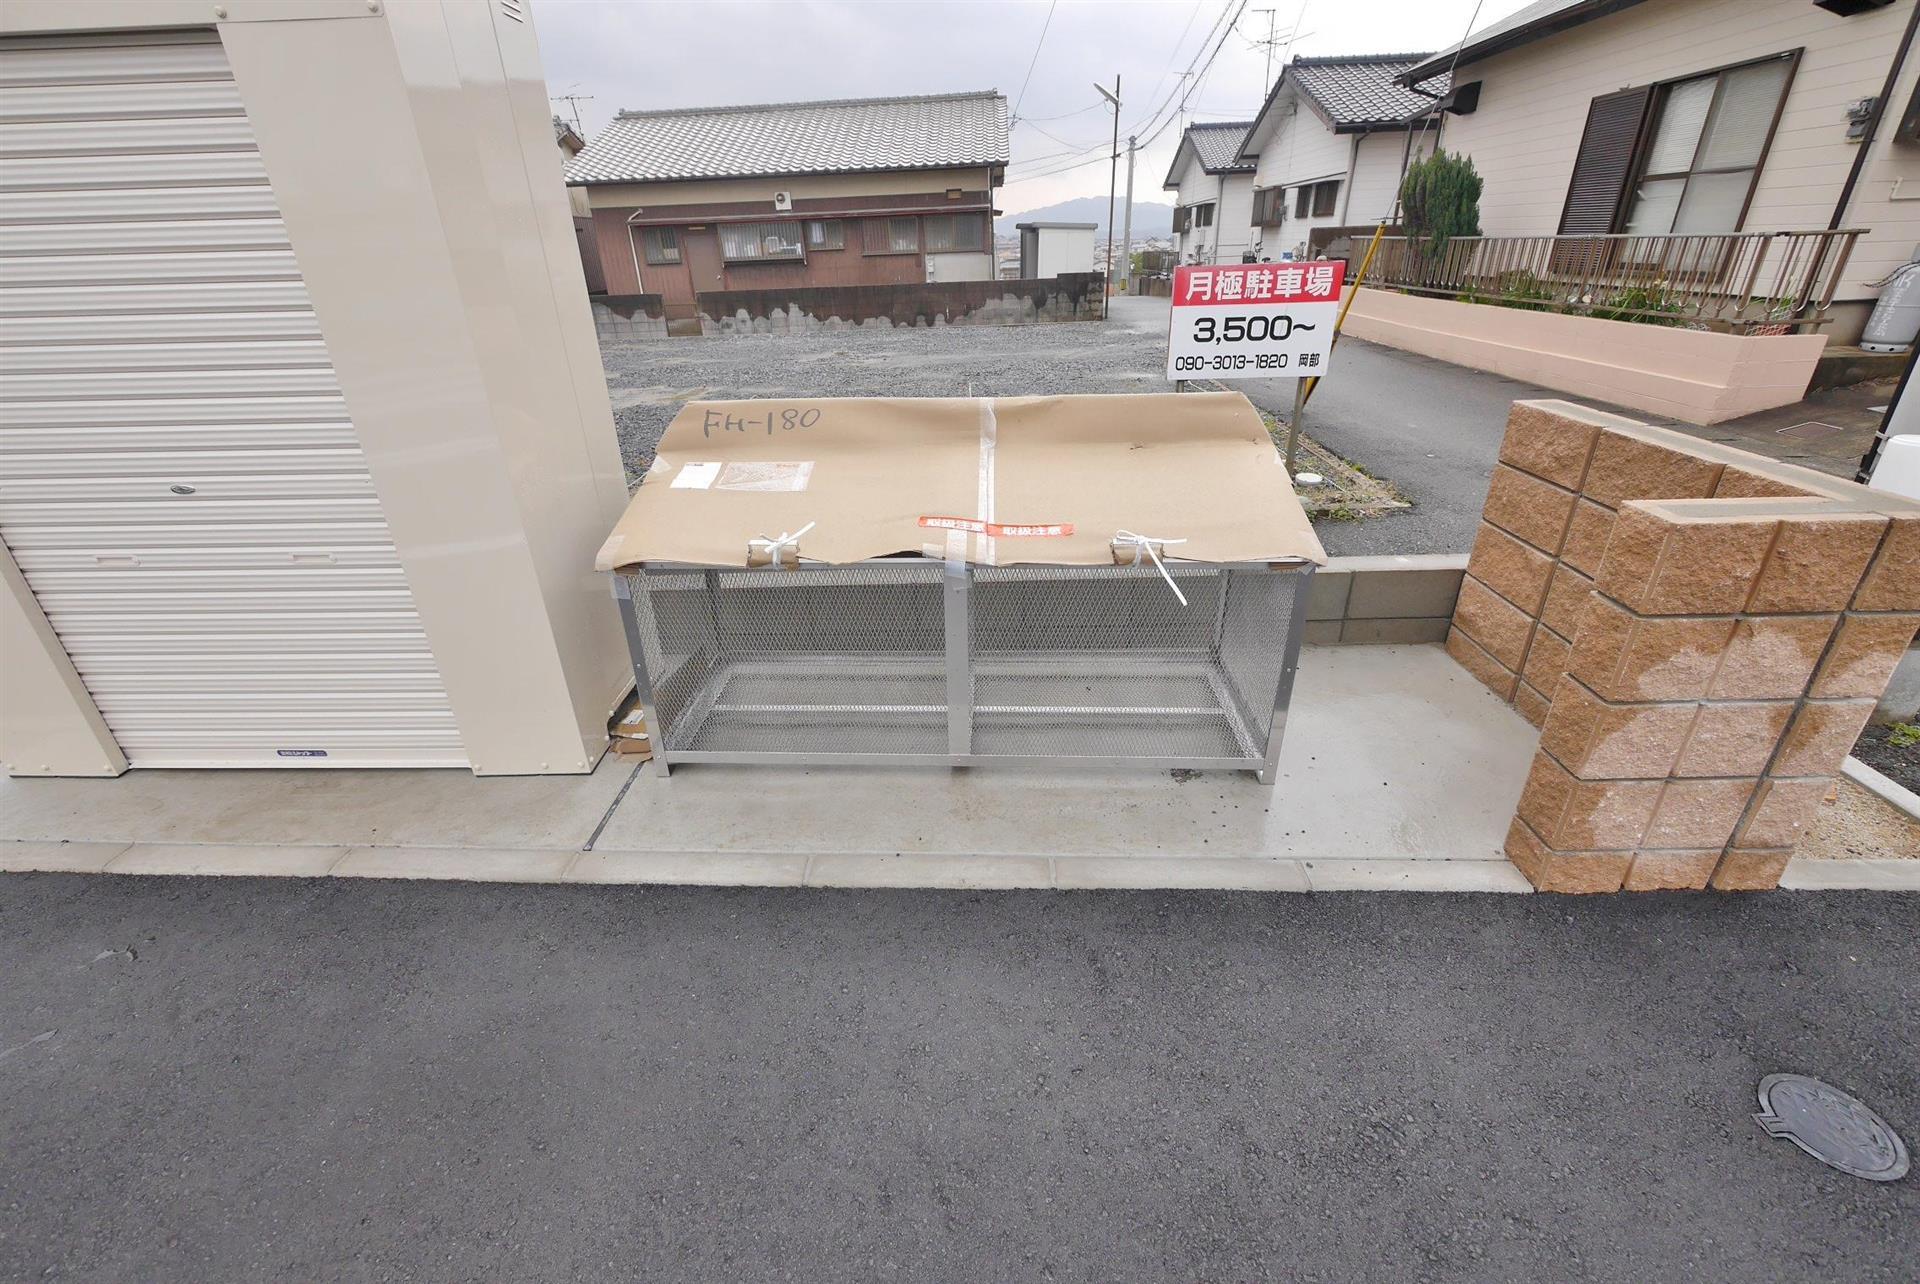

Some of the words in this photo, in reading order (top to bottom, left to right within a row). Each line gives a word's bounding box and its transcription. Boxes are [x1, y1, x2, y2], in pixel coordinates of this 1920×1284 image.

[1186, 266, 1334, 301] 月極駐車場
[1175, 354, 1288, 371] 090-3013-1820
[1298, 353, 1320, 367] 岡部
[703, 408, 821, 438] FH-180
